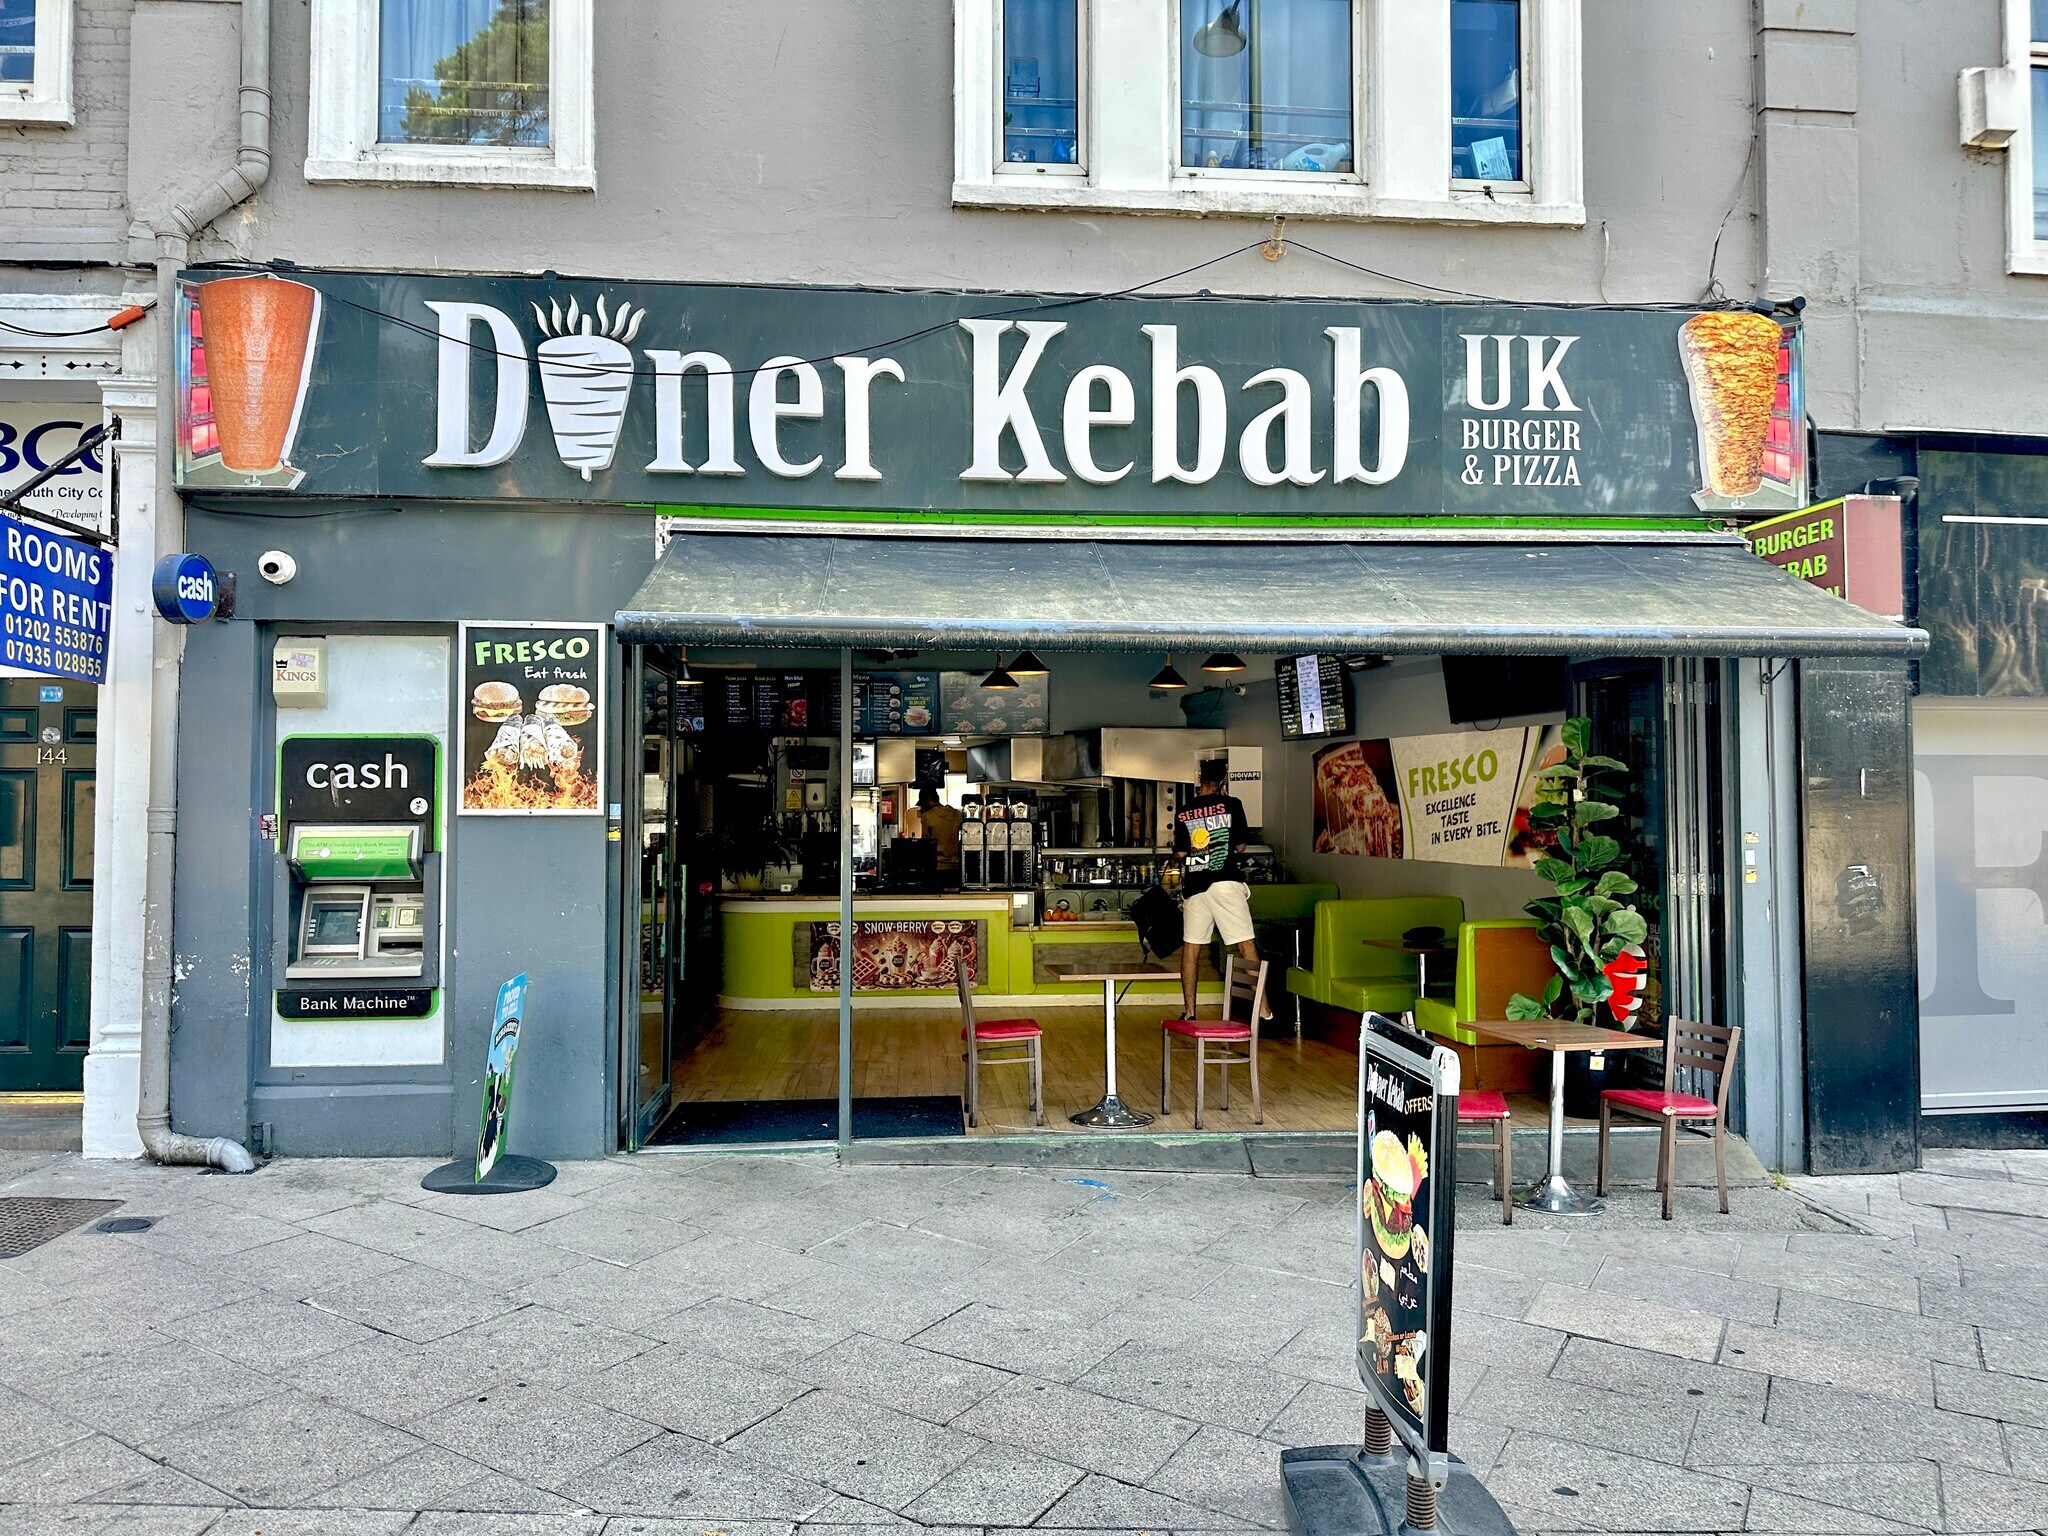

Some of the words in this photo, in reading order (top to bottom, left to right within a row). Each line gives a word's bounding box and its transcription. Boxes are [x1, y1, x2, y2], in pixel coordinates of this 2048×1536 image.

[1458, 334, 1582, 412] UK
[958, 318, 1411, 487] Kebab
[1460, 418, 1582, 451] BURGER
[1460, 454, 1485, 485] &
[1492, 454, 1582, 486] PIZZA
[58, 487, 84, 500] City
[52, 508, 98, 521] Developing
[1754, 518, 1834, 559] BURGER
[8, 527, 101, 585] ROOMS
[178, 571, 213, 602] cash
[0, 573, 45, 616] FOR
[52, 589, 111, 632] RENT
[5, 612, 50, 643] 01202
[54, 625, 103, 654] 553876
[6, 639, 51, 668] 07935
[55, 650, 102, 678] 028955
[475, 637, 590, 666] FRESCO
[524, 665, 549, 679] Eat
[553, 667, 588, 680] fresh
[37, 747, 68, 765] 144
[305, 753, 409, 789] cash
[1408, 749, 1498, 798] FRESCO
[1178, 803, 1226, 823] SERIES
[1426, 793, 1476, 815] EXCELLENCE
[1206, 814, 1231, 831] SLAM
[1441, 811, 1469, 829] TASTE
[1444, 827, 1472, 844] EVERY
[1185, 854, 1210, 866] IN
[300, 997, 338, 1010] Bank
[1404, 1095, 1434, 1115] OFFERS
